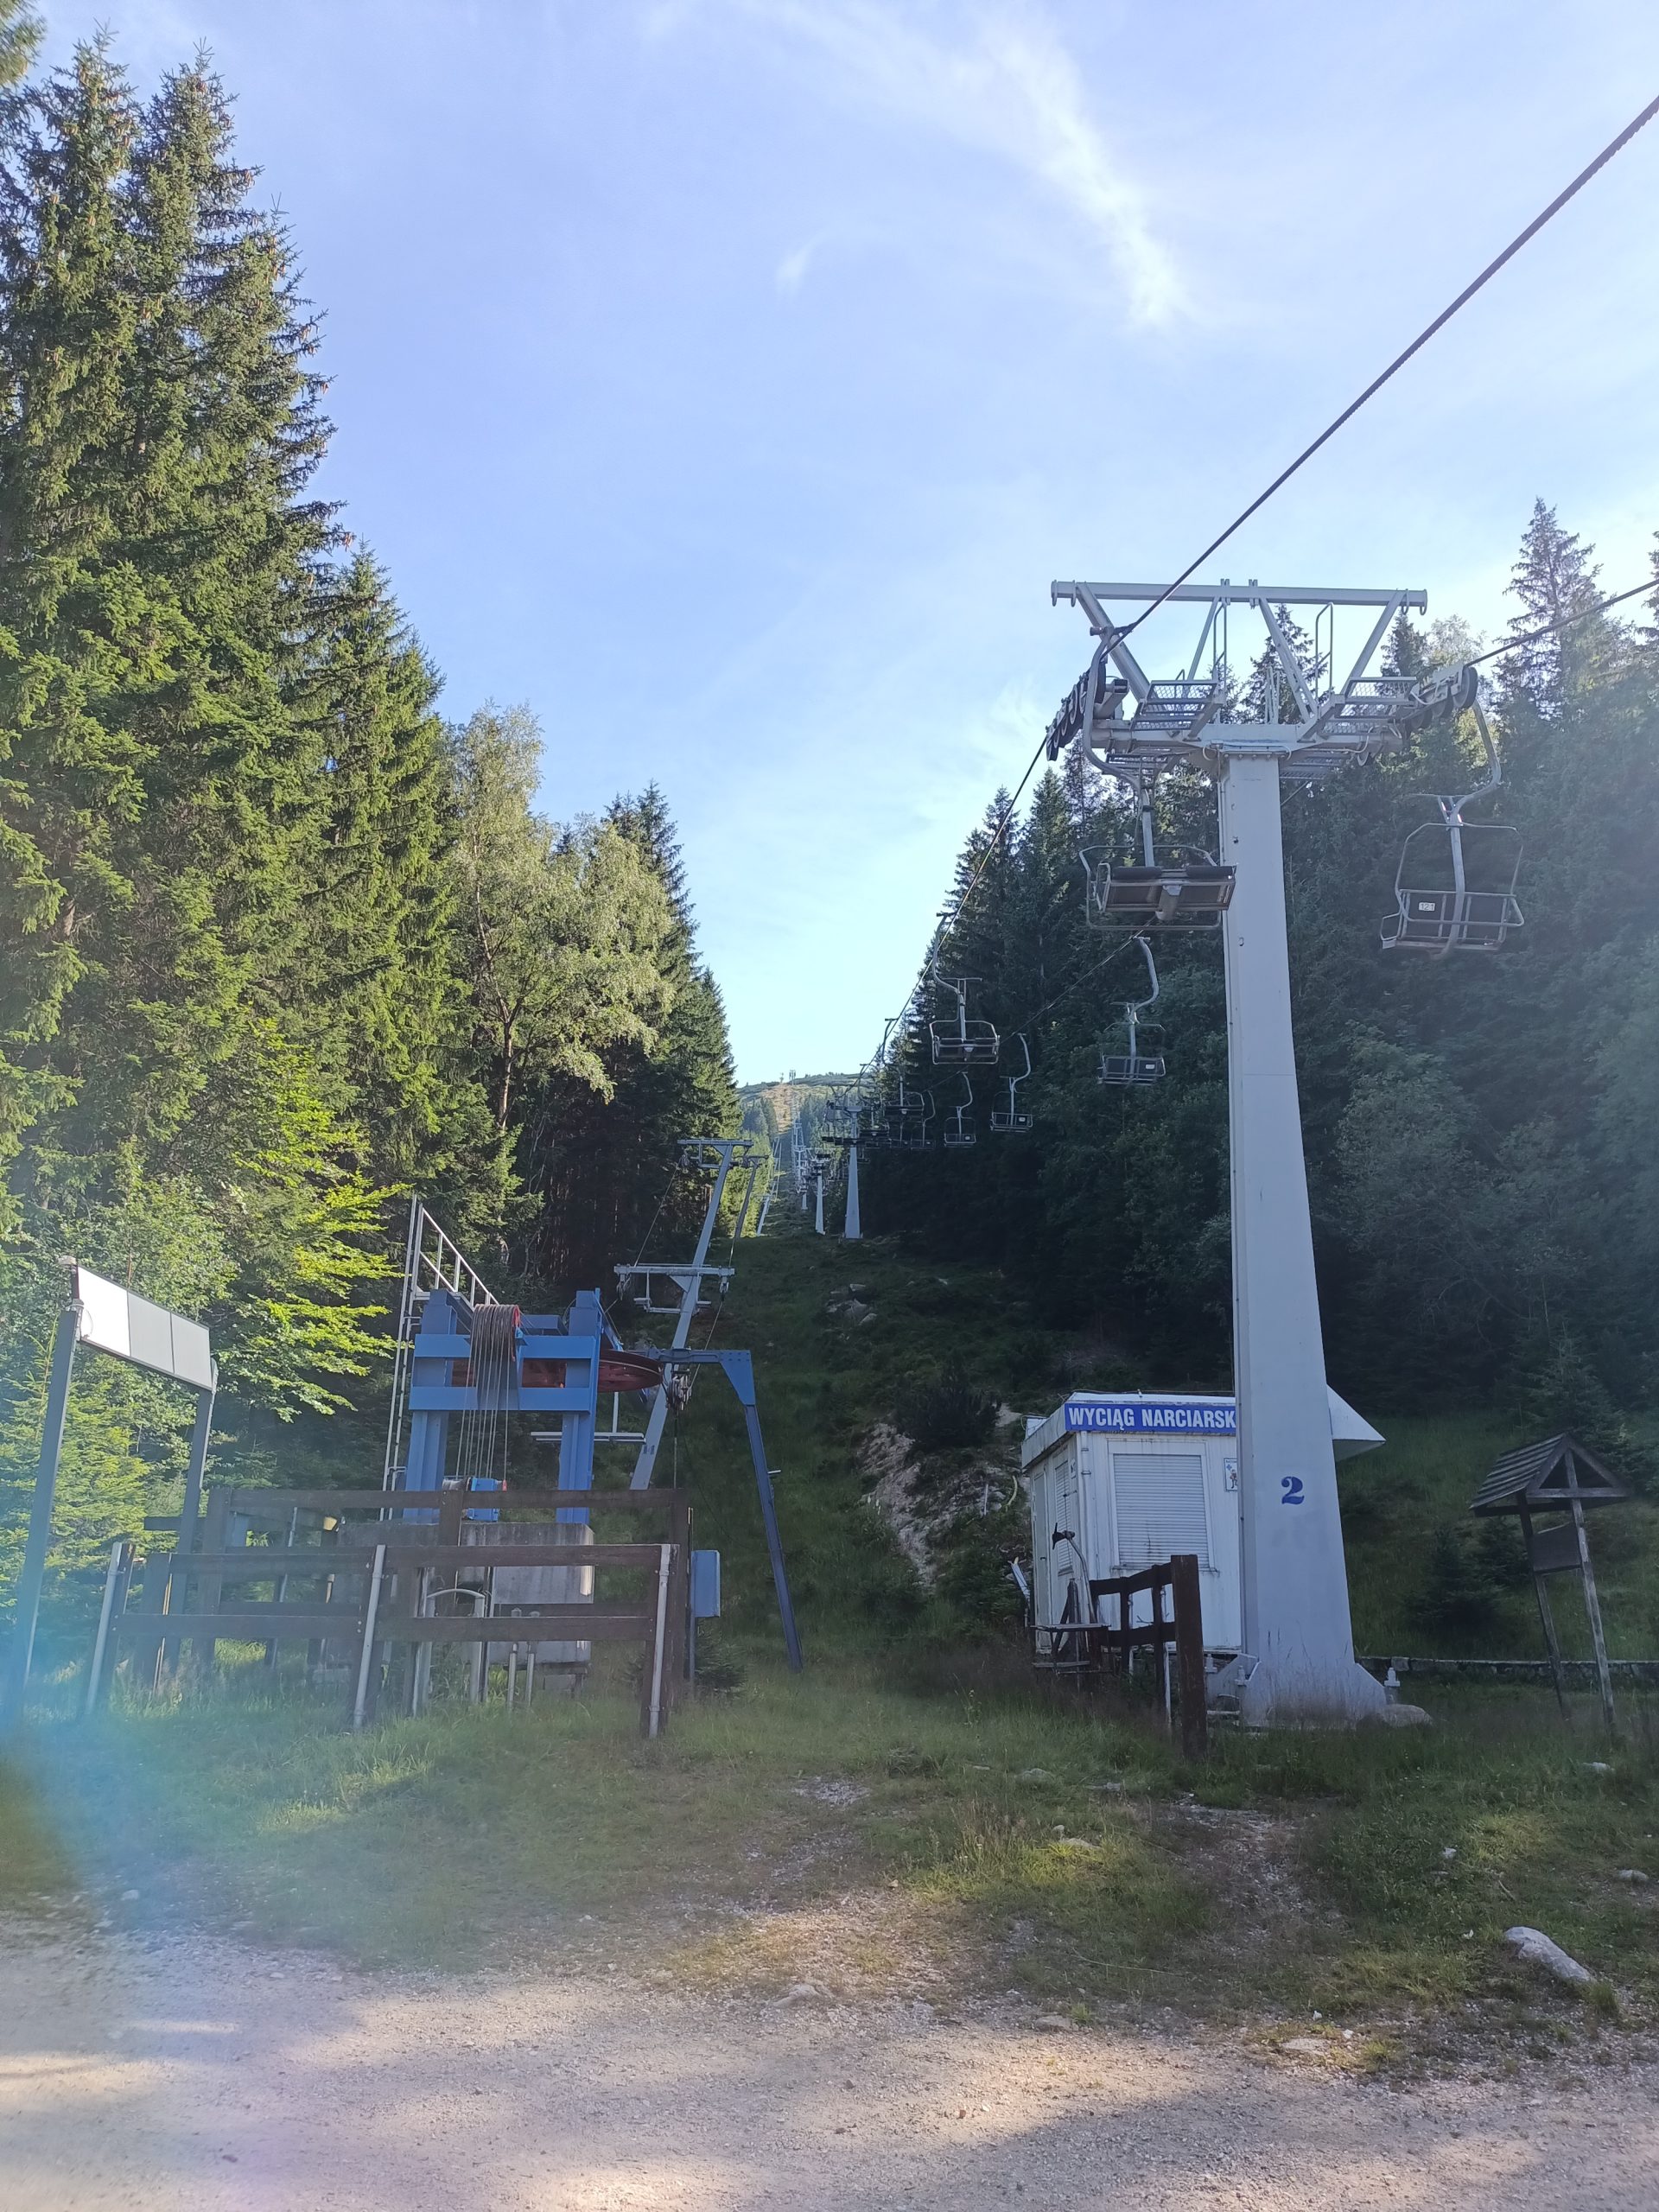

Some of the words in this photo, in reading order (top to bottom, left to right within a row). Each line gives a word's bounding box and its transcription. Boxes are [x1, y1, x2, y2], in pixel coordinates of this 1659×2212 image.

[1068, 1408, 1135, 1431] WYCIĄG
[1141, 1408, 1236, 1428] NARCIARSK
[1281, 1476, 1305, 1505] 2
